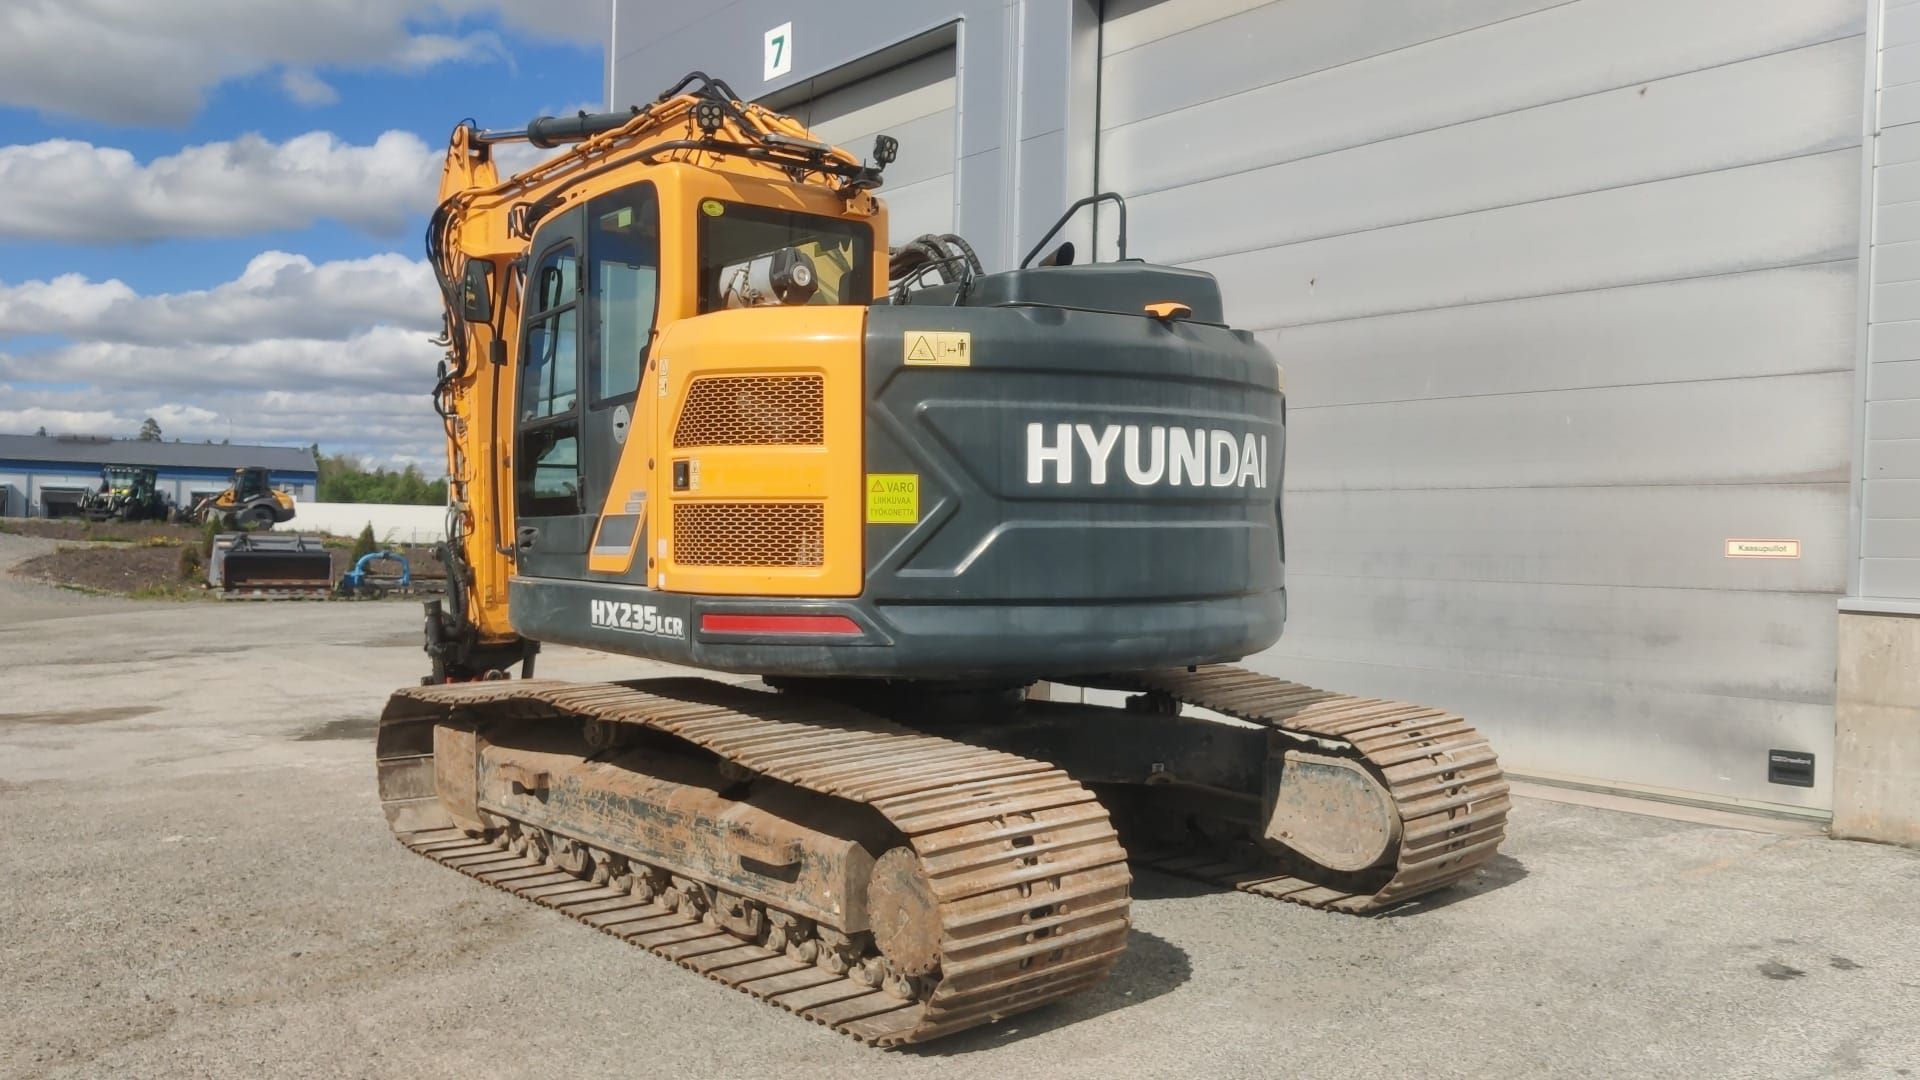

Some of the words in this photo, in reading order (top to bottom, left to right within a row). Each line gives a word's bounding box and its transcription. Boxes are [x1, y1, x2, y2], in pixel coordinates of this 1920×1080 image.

[771, 35, 785, 69] 7
[1026, 422, 1267, 489] HYUNDAI
[886, 482, 914, 493] VARO
[591, 599, 684, 637] HX235LCR
